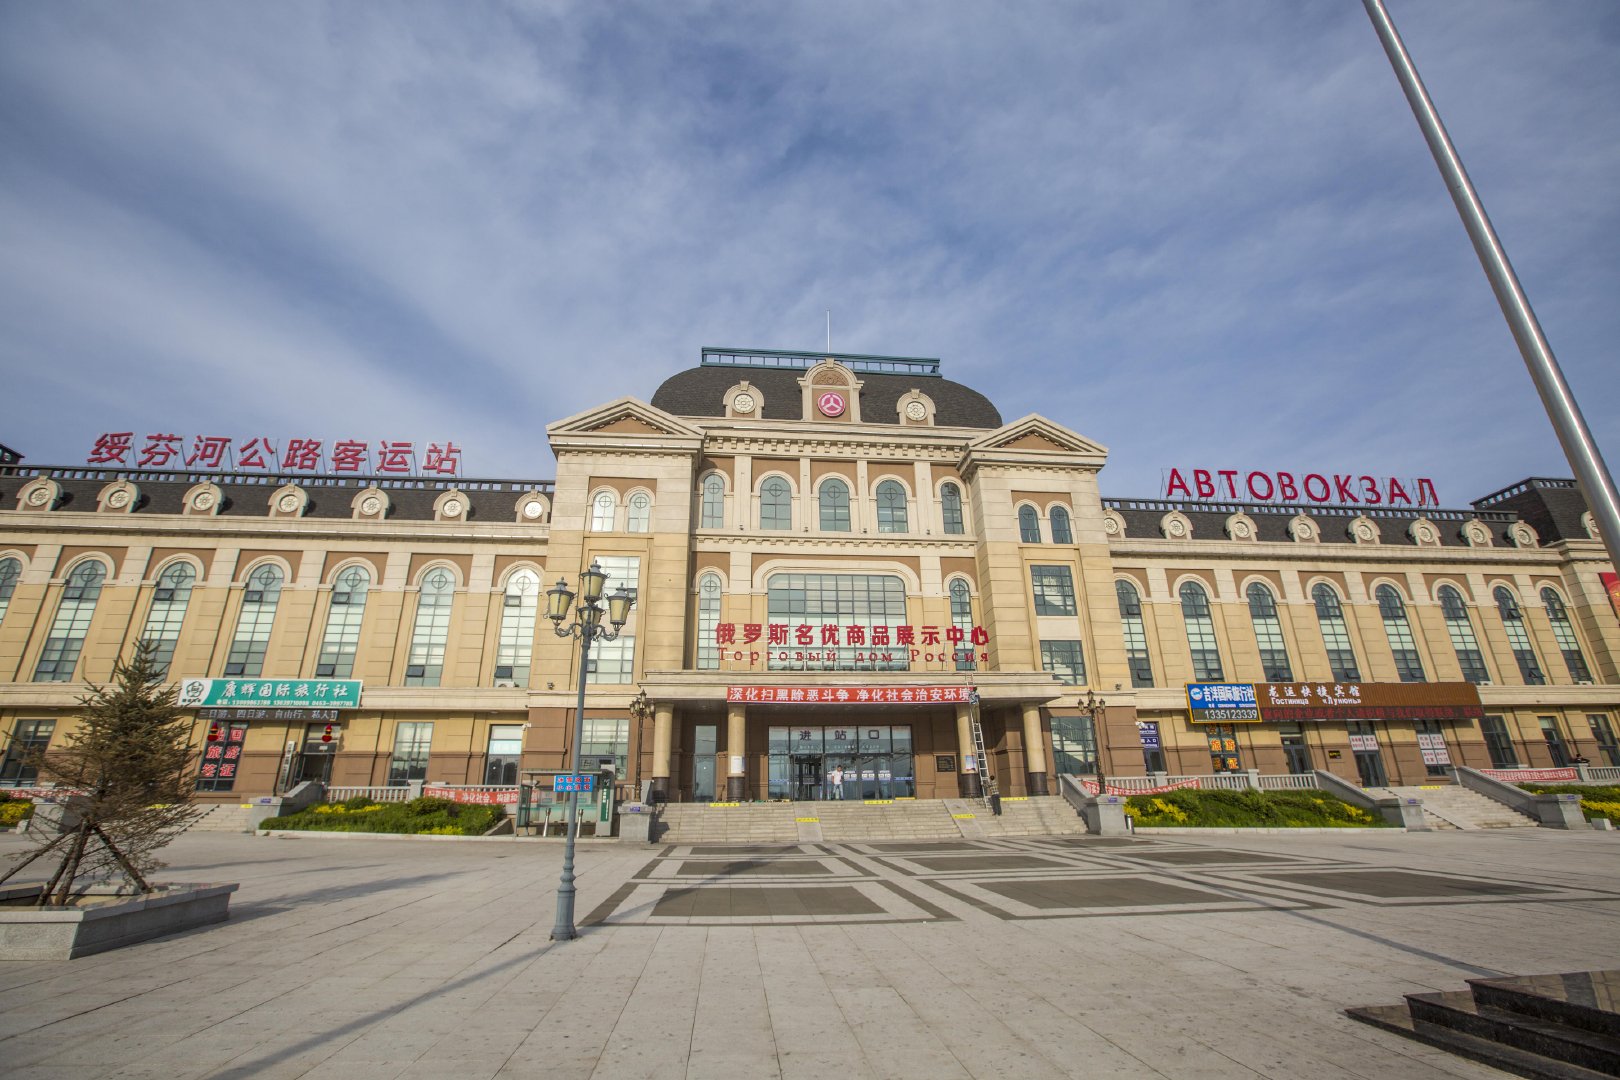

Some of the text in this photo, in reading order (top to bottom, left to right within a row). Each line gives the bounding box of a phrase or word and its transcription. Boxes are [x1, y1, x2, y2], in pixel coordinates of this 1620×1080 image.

[87, 432, 461, 475] 绥芬河公路客运站
[1167, 468, 1439, 506] АВТОВОКЗАЛ
[715, 623, 989, 646] 俄罗斯名优商品展示中心
[717, 647, 989, 665] Торговый дом Россия
[222, 681, 348, 697] 康辉国际旅行社
[730, 687, 970, 701] 深化扫黑除恶斗争 净化社会治安环境
[1203, 685, 1256, 702] 吉洋国际旅行社
[1205, 709, 1257, 719] 1335123339
[800, 730, 880, 741] 进站口
[206, 745, 240, 759] 旅游
[201, 763, 235, 777] 签证
